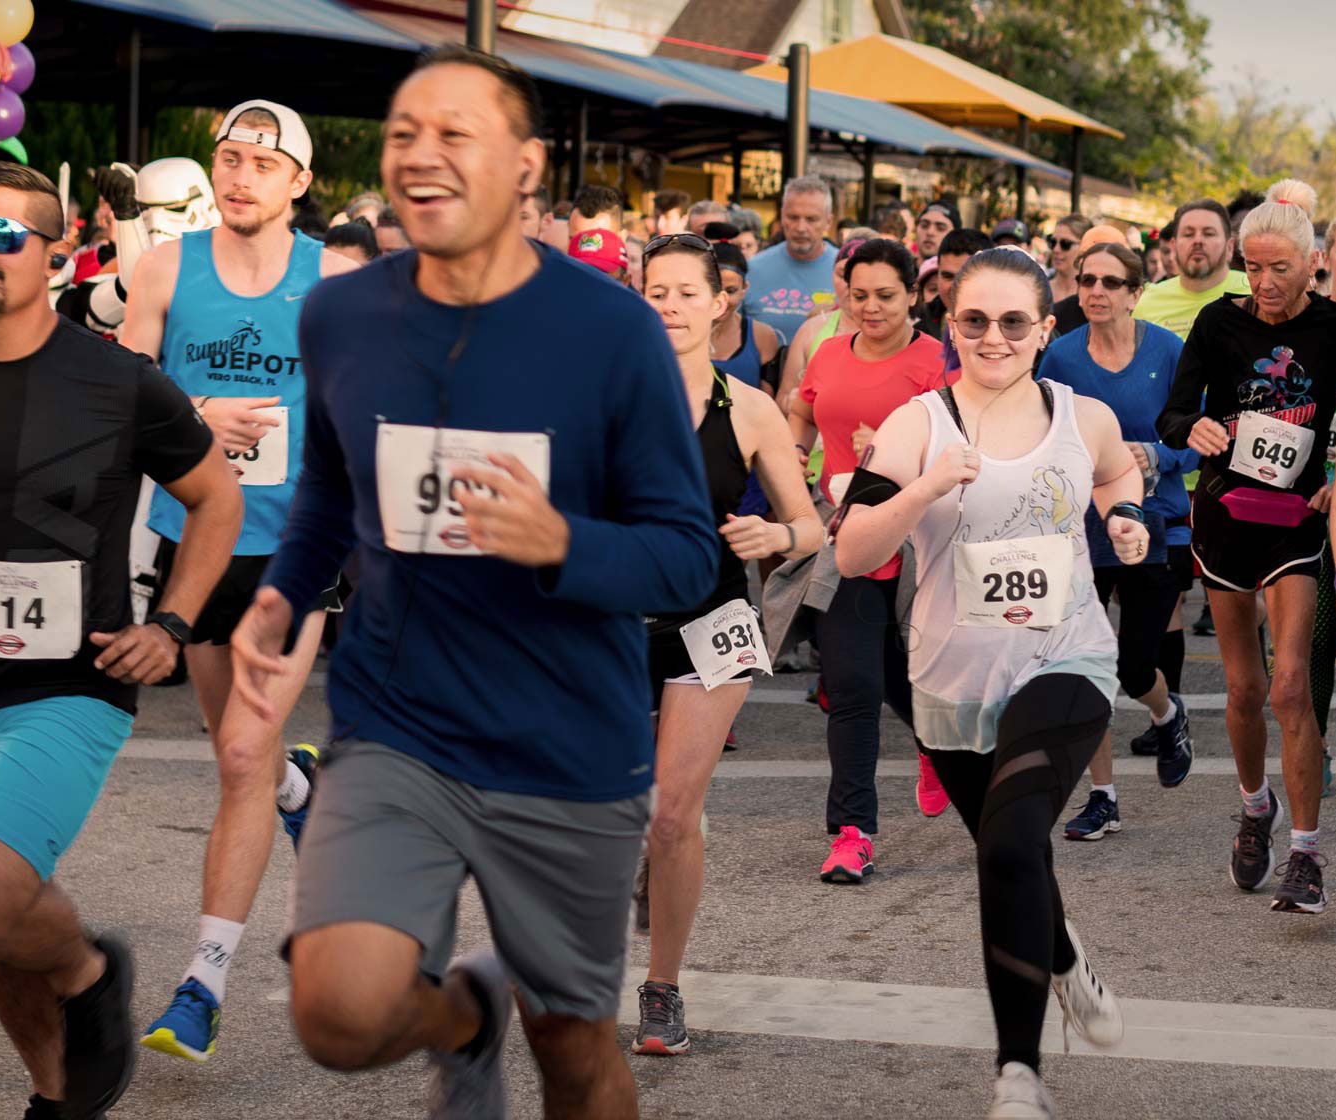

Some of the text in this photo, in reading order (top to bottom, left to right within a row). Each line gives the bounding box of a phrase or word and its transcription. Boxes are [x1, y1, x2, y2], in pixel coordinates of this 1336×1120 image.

[186, 329, 262, 364] Runner's
[207, 372, 231, 382] VERO
[266, 378, 277, 386] FL
[209, 351, 303, 376] DEPOT
[1252, 437, 1298, 470] 649
[989, 552, 1038, 566] CHALLENGE
[982, 568, 1048, 602] 289
[711, 623, 757, 656] 938
